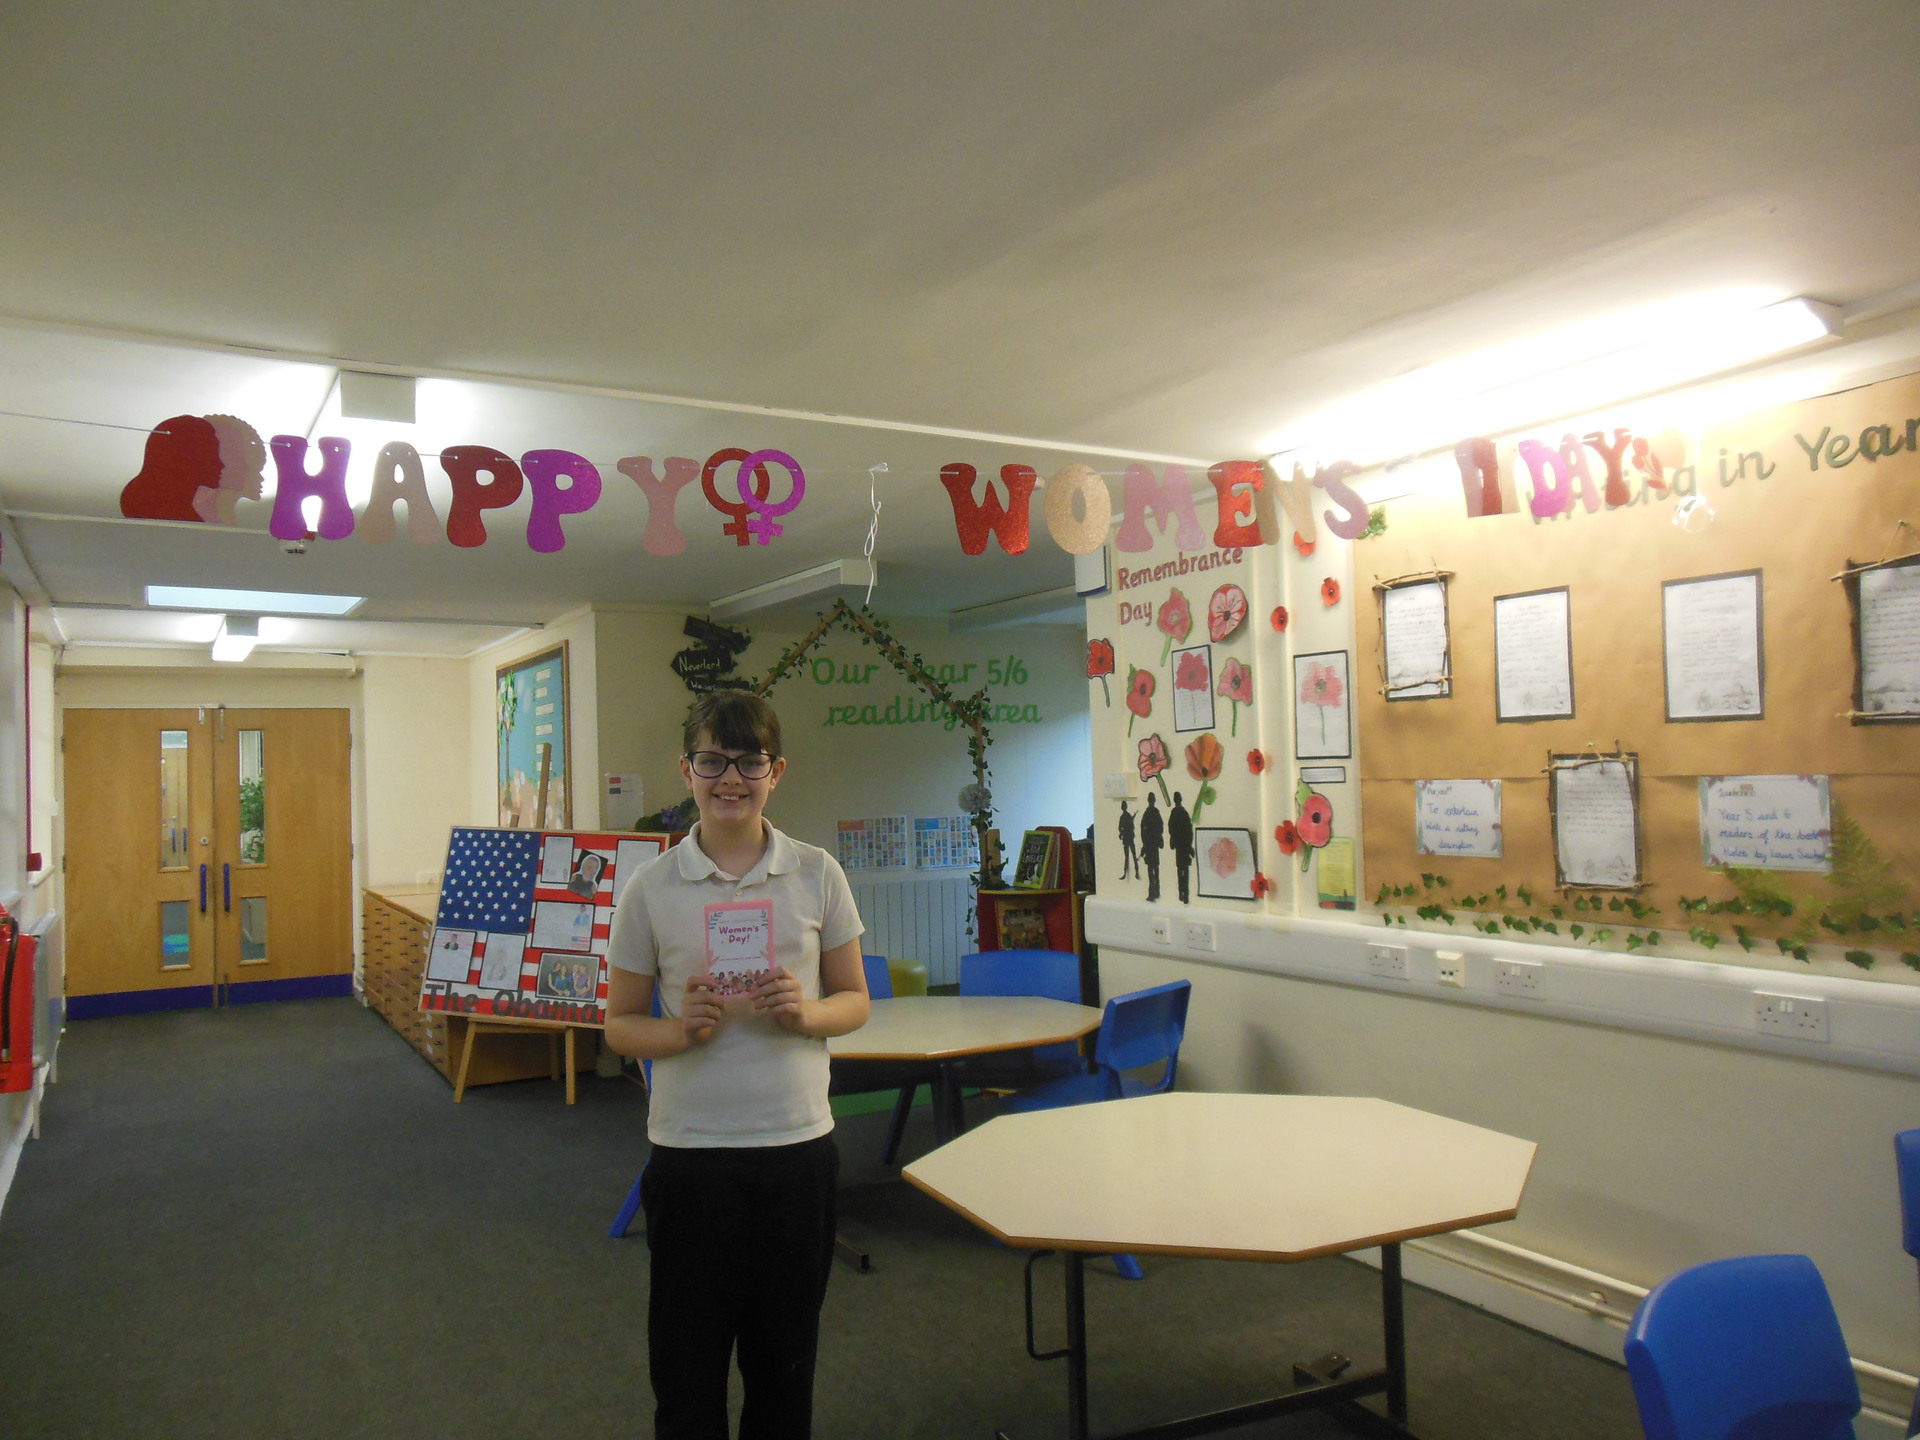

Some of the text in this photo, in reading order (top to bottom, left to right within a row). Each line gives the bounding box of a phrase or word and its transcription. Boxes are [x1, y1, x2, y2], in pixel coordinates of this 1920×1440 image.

[1719, 448, 1776, 488] in
[269, 434, 700, 557] HAPPY
[1518, 428, 1632, 517] DAY
[1118, 546, 1243, 591] Remembrance
[1120, 602, 1152, 626] Day
[679, 656, 720, 673] Neverland
[812, 654, 1028, 687] Our ear 5/6
[1427, 803, 1439, 815] To
[1719, 808, 1740, 821] Year
[1758, 810, 1778, 821] and
[1784, 808, 1792, 820] 6
[1757, 829, 1769, 845] of
[1775, 829, 1793, 840] the
[1755, 847, 1767, 863] by
[719, 924, 760, 935] Women's
[728, 933, 750, 945] Day!
[425, 982, 605, 1026] The Obama
